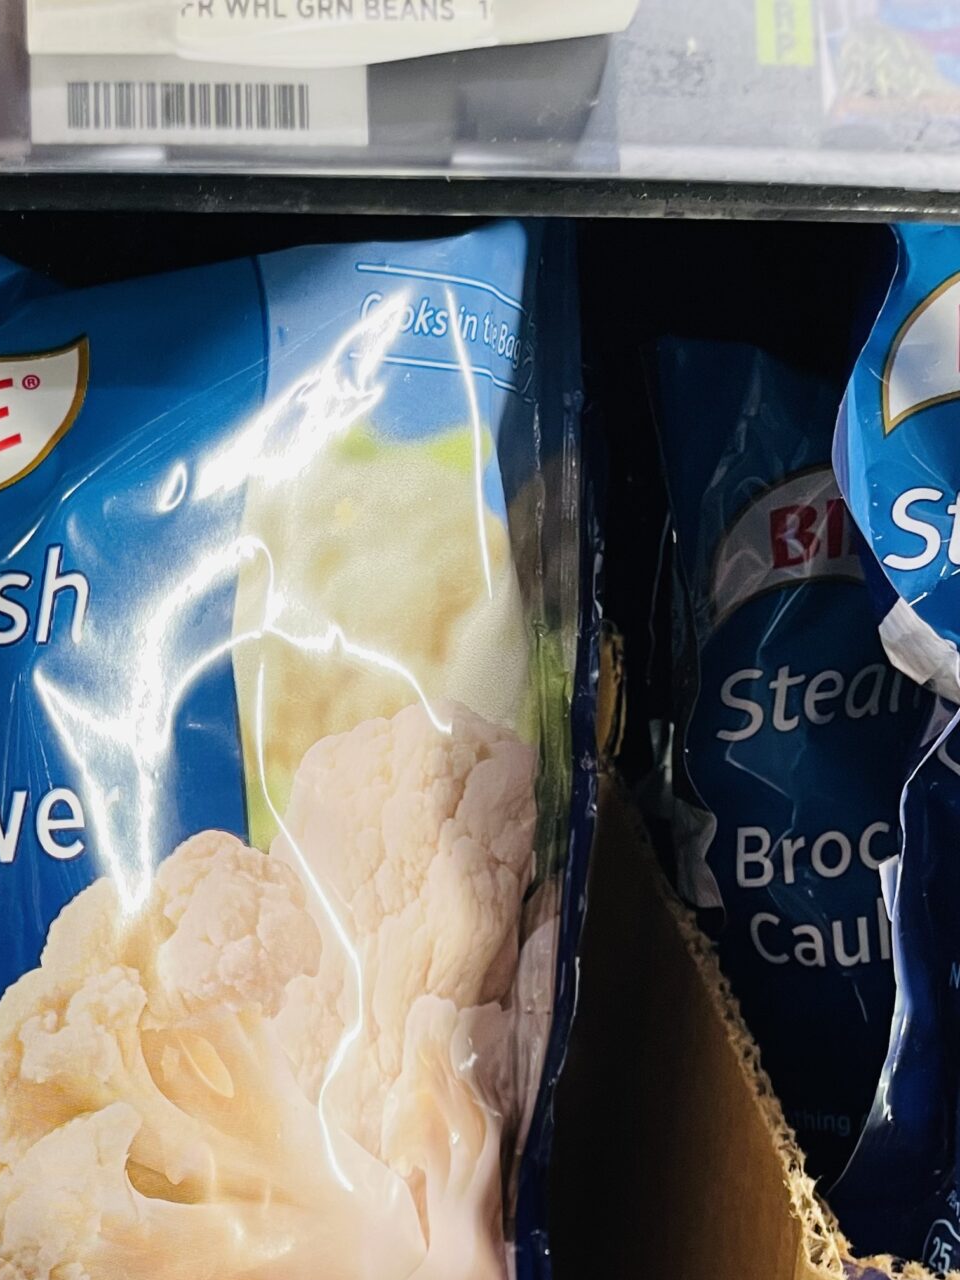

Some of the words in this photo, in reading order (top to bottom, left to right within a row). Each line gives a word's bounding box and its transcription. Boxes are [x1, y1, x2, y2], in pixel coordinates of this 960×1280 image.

[227, 0, 286, 18] WHL
[297, 0, 352, 19] GRN
[365, 0, 453, 20] BEANS
[360, 290, 449, 336] Coks
[458, 305, 478, 342] in
[498, 321, 522, 369] Bag
[929, 1236, 953, 1273] 25
